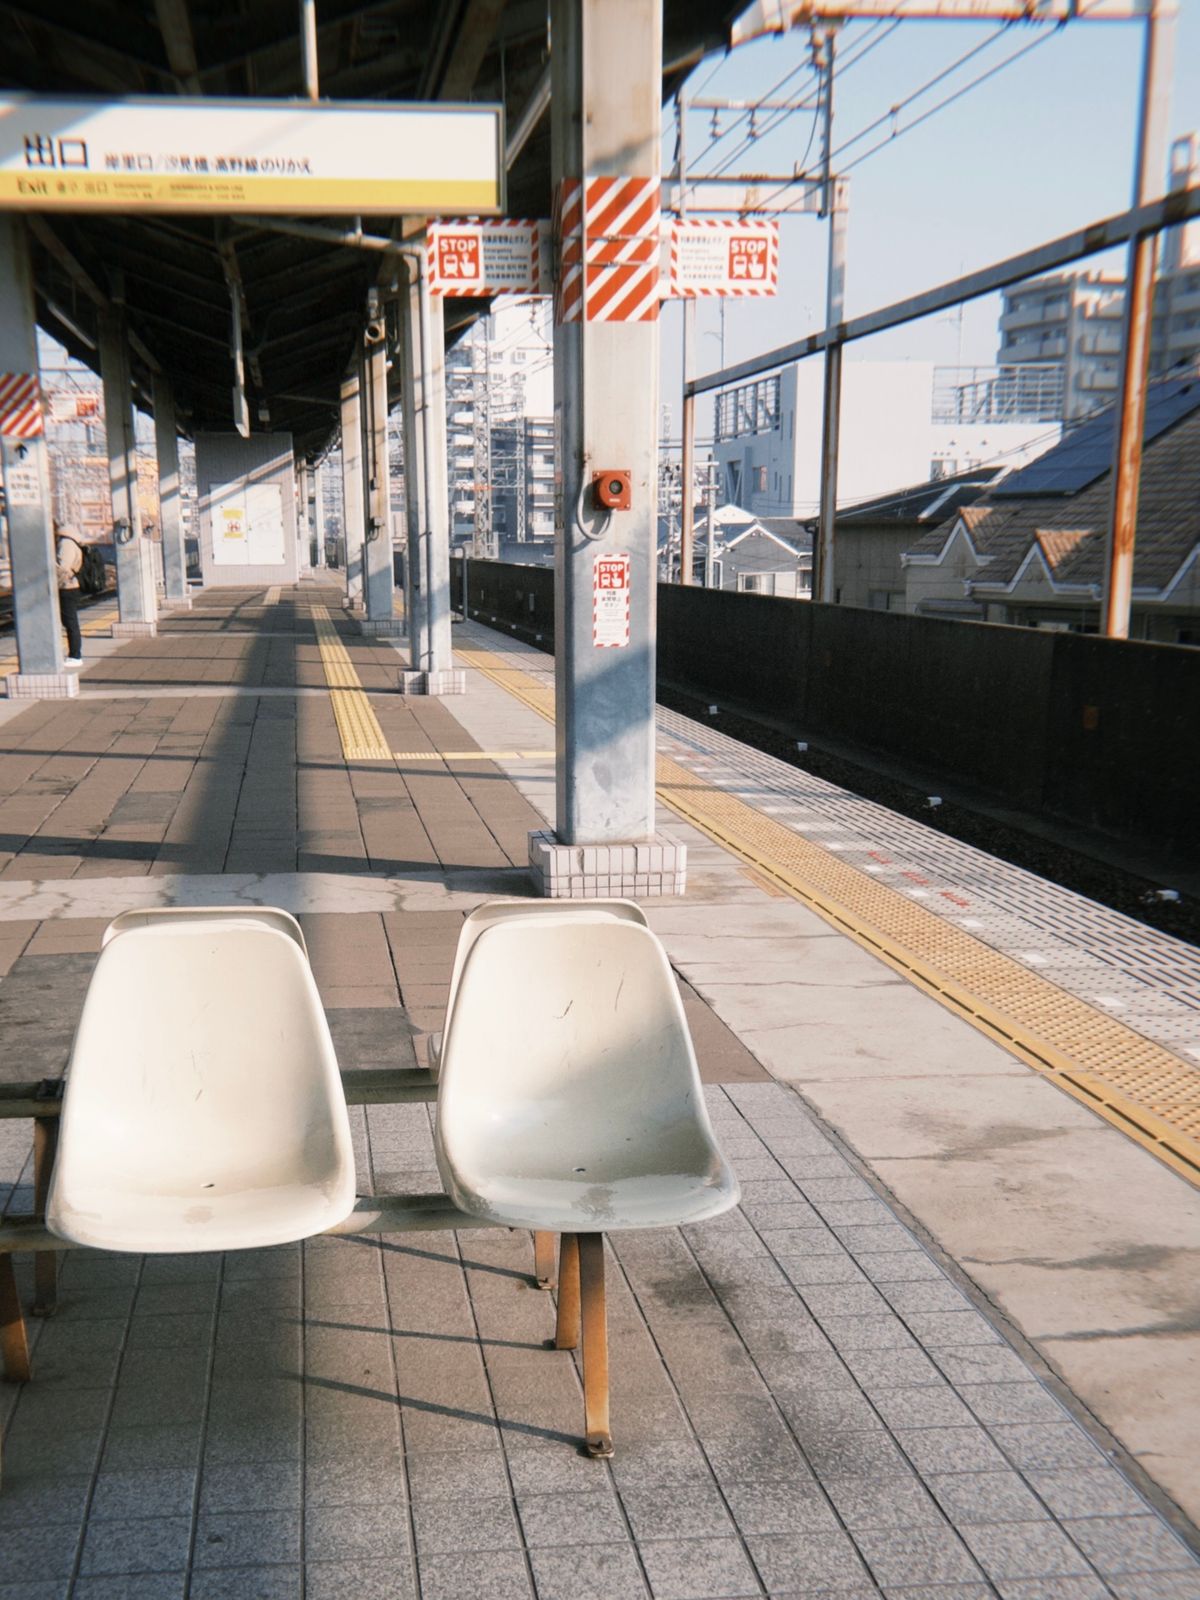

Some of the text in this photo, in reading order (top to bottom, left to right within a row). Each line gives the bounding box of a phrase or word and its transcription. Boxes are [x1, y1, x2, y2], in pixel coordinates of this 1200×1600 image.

[23, 132, 88, 168] 出口
[17, 176, 48, 194] Exit
[440, 239, 477, 252] STOP
[731, 240, 766, 253] STOP
[600, 563, 624, 573] STOP
